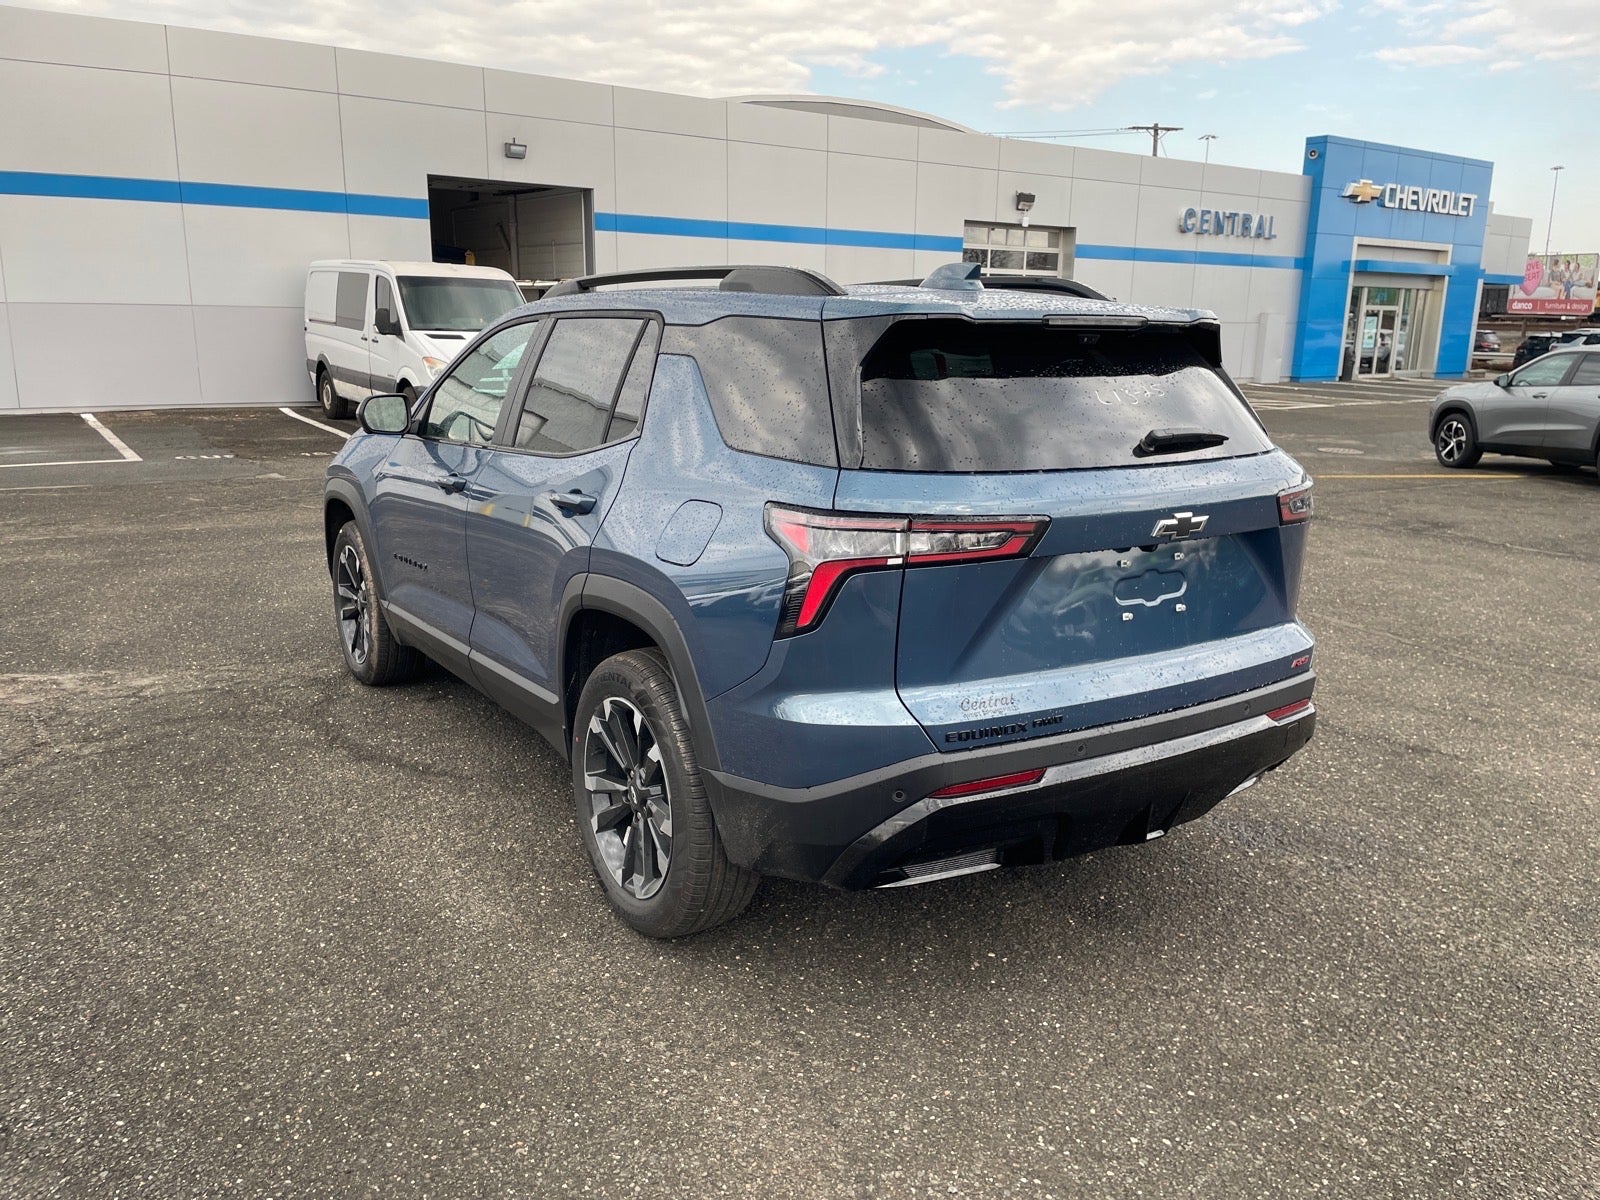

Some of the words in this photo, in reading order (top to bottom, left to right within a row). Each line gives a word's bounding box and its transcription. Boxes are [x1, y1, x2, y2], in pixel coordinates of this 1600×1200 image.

[1384, 183, 1478, 217] CHEVROLET
[1179, 207, 1277, 240] CENTRAL
[1526, 261, 1540, 272] OVE
[1512, 301, 1533, 310] danco
[1545, 302, 1565, 310] furniture
[1571, 303, 1589, 312] design
[960, 693, 1017, 712] Central
[945, 721, 1028, 743] EQUINOX
